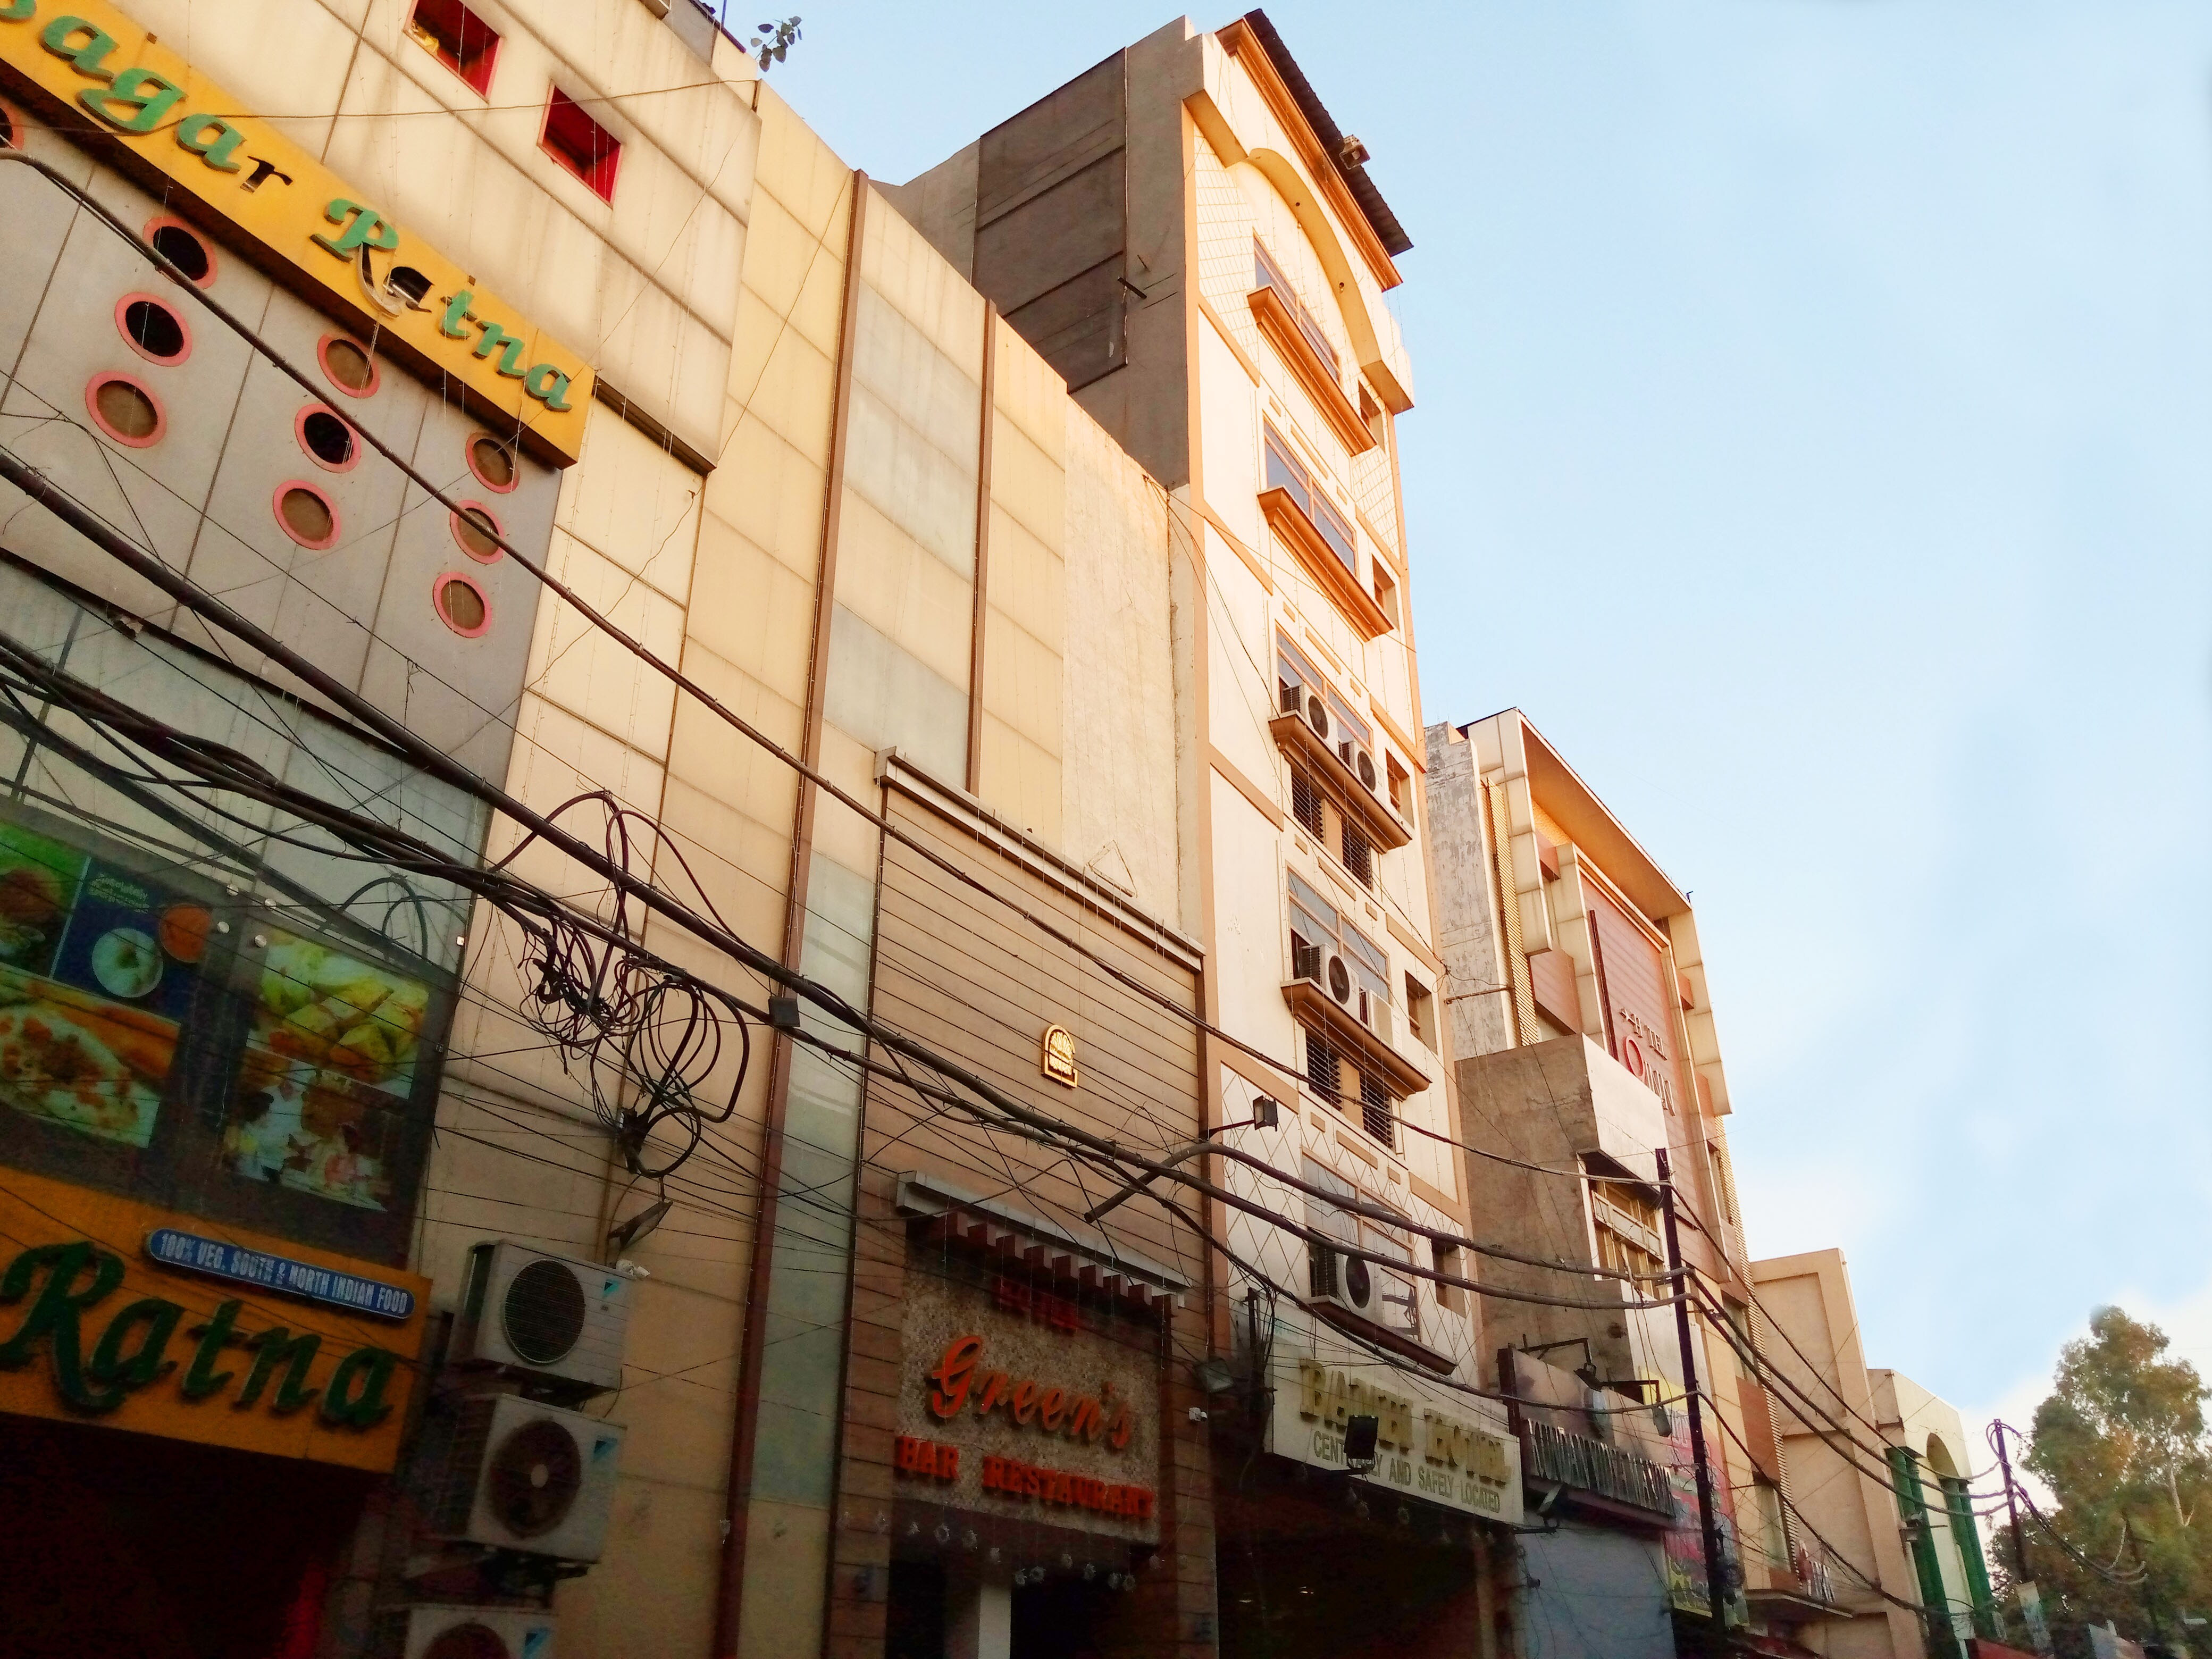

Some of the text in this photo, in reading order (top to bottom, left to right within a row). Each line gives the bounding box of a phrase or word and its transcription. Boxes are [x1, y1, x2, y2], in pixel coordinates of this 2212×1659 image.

[160, 1233, 196, 1262] 100%
[230, 1250, 275, 1283] SOUTH
[275, 1261, 286, 1285] &
[288, 1264, 331, 1295] NORTH
[331, 1275, 375, 1307] INDIAN
[375, 1286, 408, 1314] FOOD
[0, 1241, 398, 1426] Ratna
[932, 1335, 1132, 1449] Green's
[894, 1435, 959, 1480] BAR
[1388, 1457, 1412, 1486] AND
[1418, 1465, 1454, 1499] SAFELY
[1460, 1480, 1501, 1514] LOCATED
